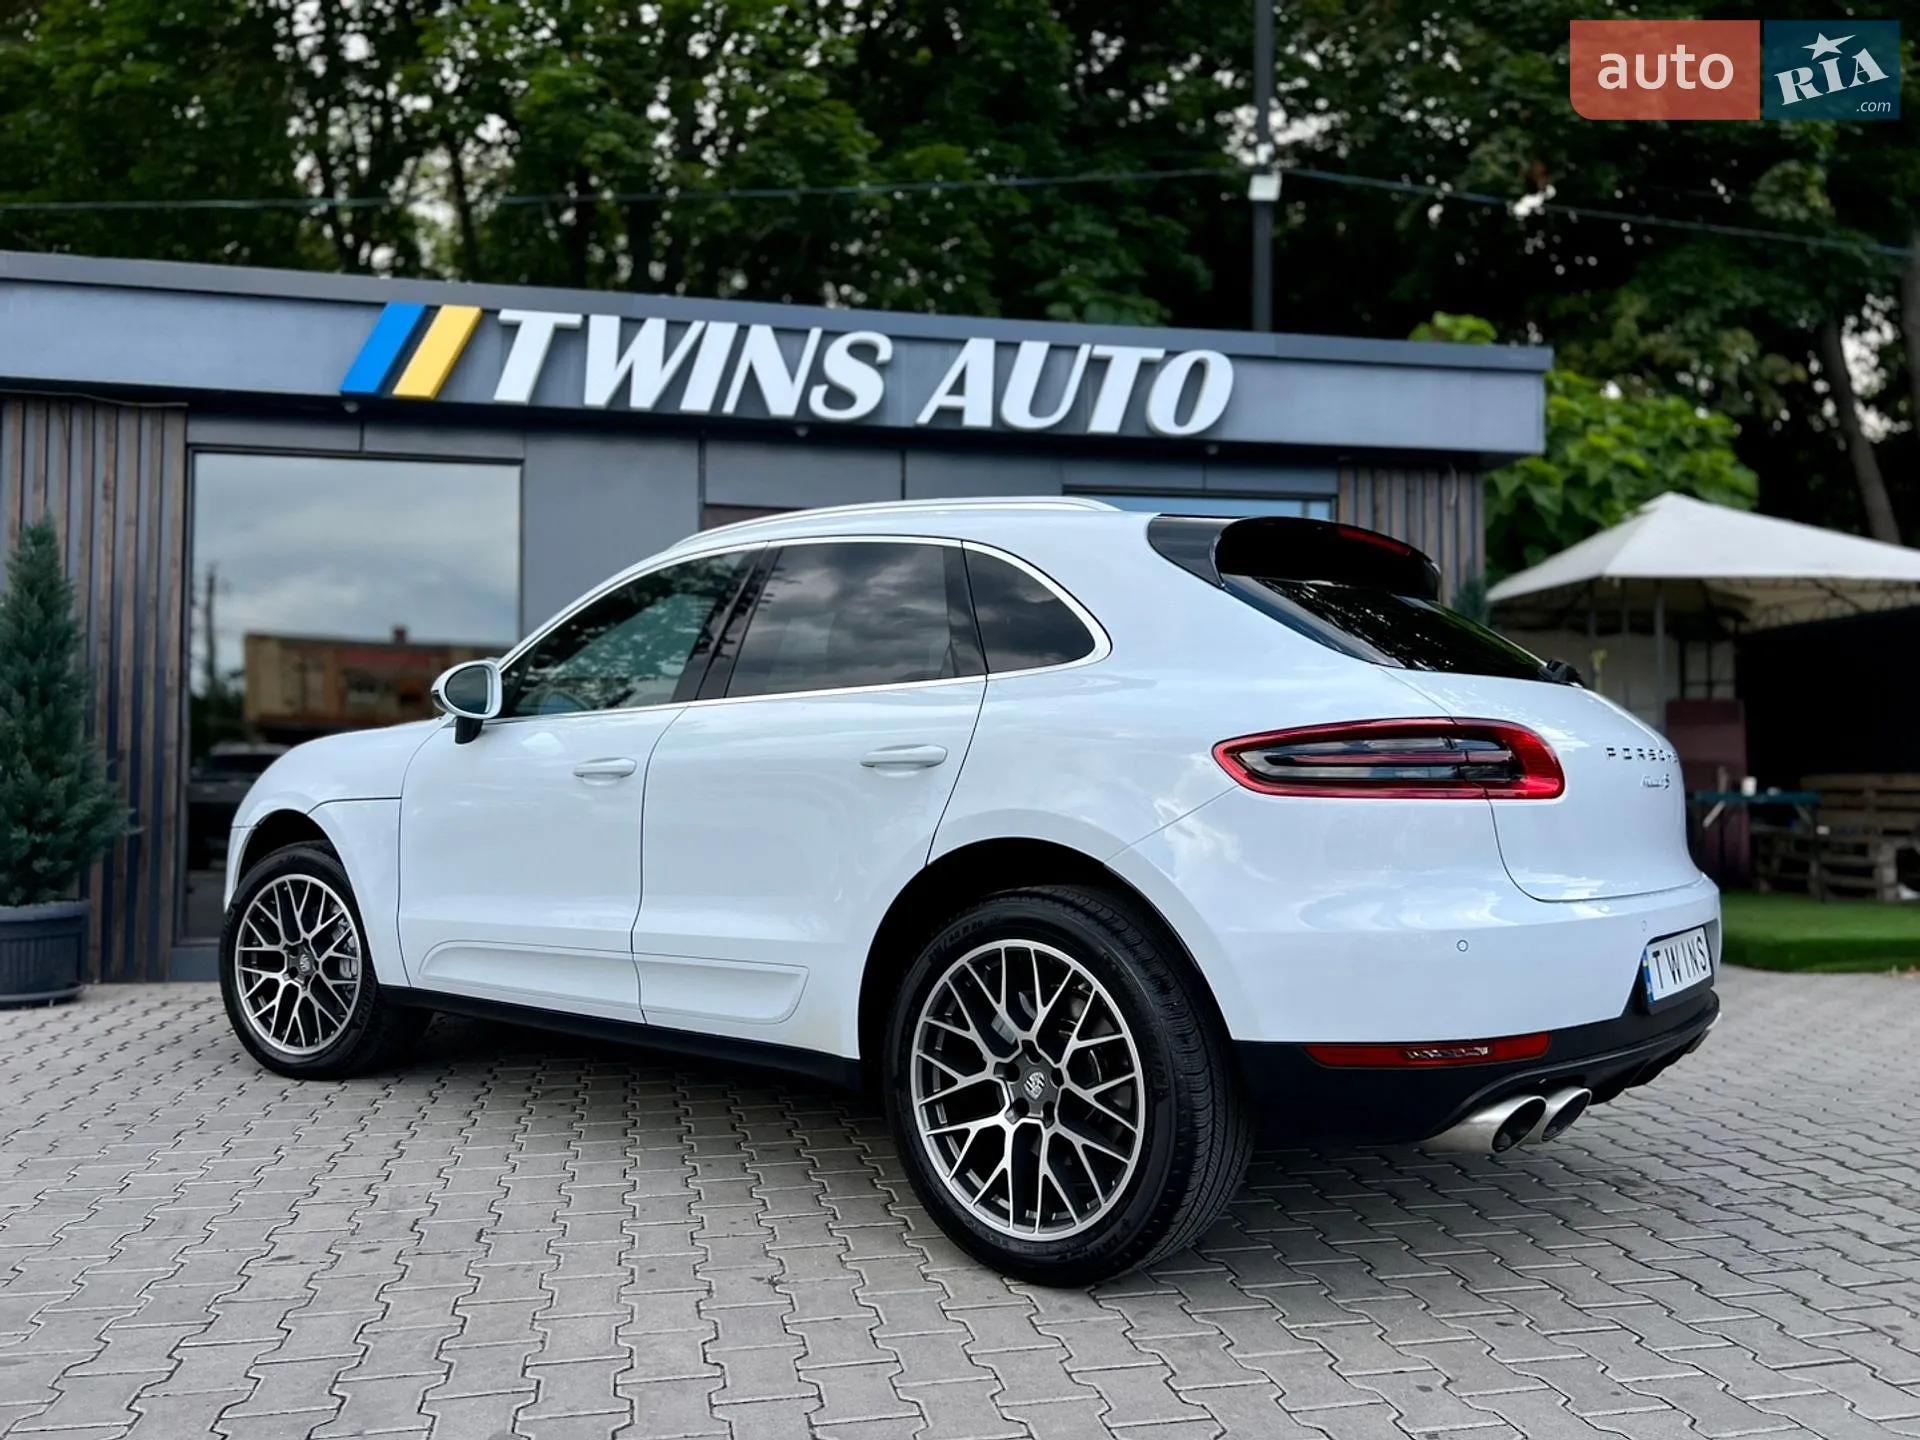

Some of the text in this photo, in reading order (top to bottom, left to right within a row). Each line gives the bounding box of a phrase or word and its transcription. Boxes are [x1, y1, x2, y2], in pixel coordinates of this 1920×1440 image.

[493, 309, 1234, 436] TWINS AUTO
[1651, 935, 1707, 989] TWINS
